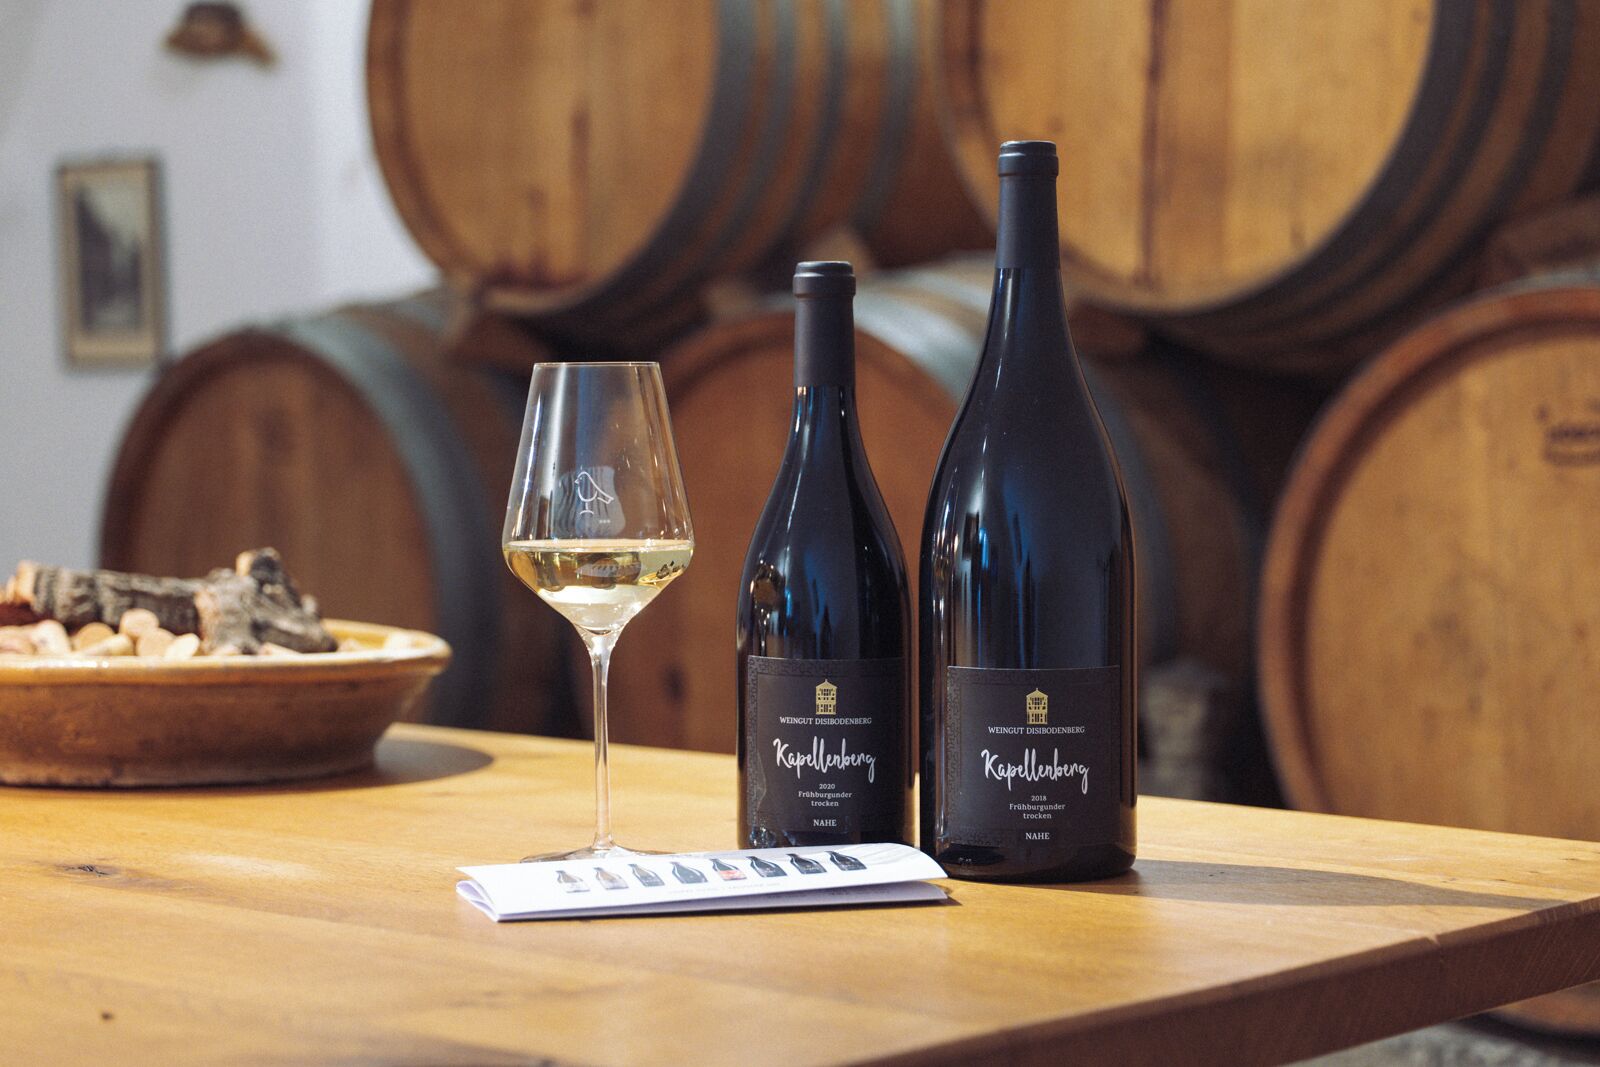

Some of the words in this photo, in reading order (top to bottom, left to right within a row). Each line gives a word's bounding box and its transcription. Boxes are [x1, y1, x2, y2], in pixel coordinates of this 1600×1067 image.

[779, 716, 813, 725] WEINGUT
[815, 717, 872, 725] DISIBODENBERG
[988, 726, 1025, 734] WEINGUT
[1026, 726, 1086, 734] DISIBODENBERG
[773, 735, 876, 784] Kapellenberg
[981, 748, 1090, 795] Kapellenberg
[798, 791, 852, 800] Frühburgunder
[1009, 803, 1066, 812] Frühburgunder
[813, 819, 837, 827] NAHE
[1025, 832, 1050, 840] NAHE
